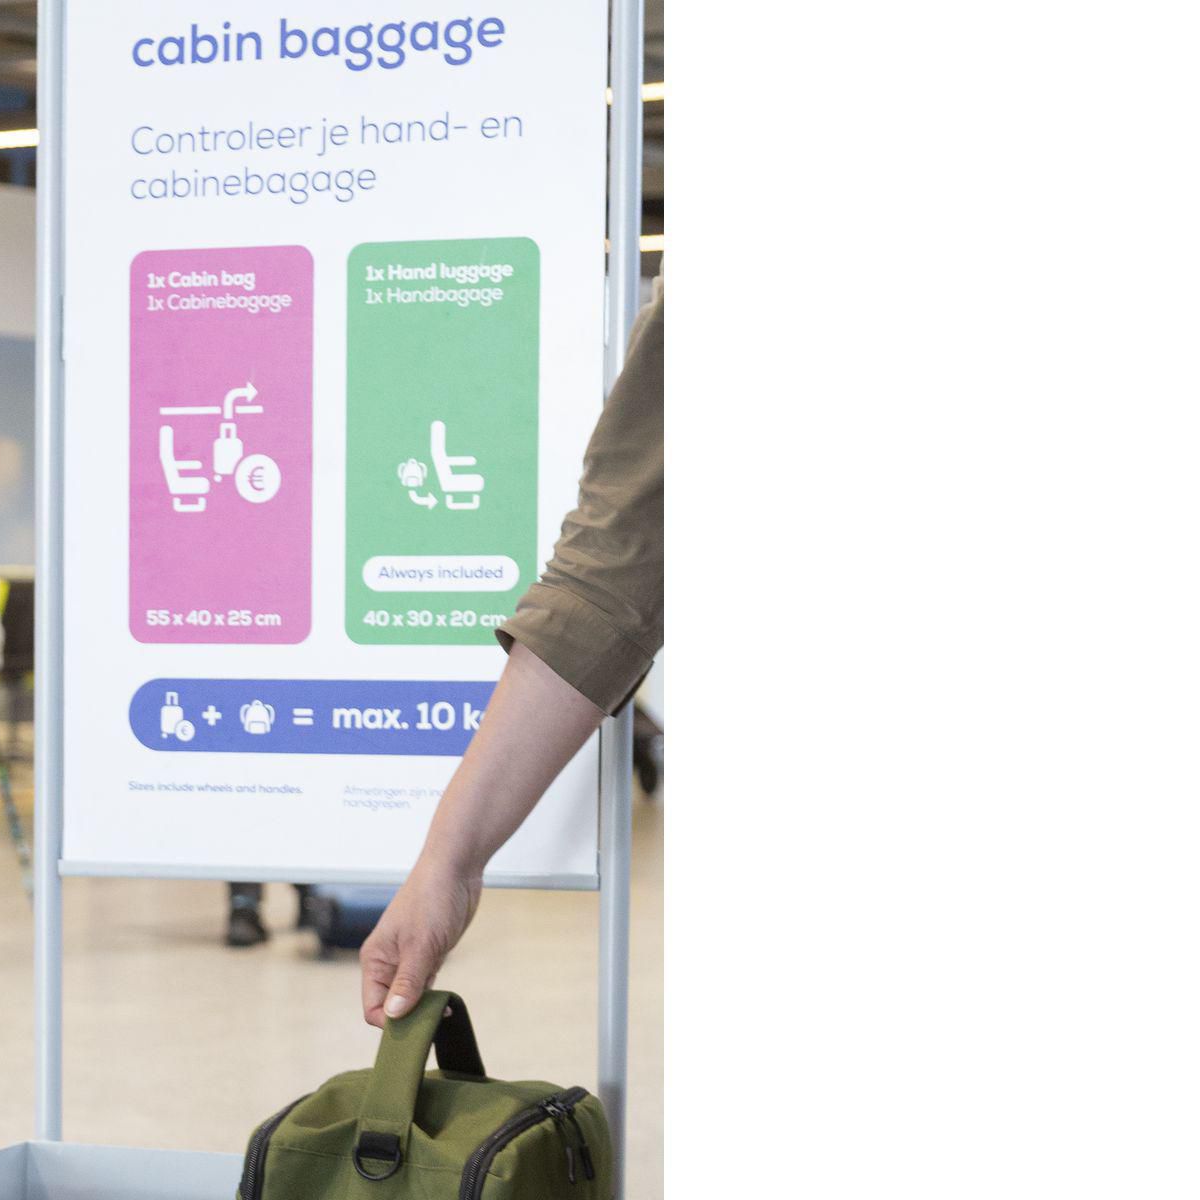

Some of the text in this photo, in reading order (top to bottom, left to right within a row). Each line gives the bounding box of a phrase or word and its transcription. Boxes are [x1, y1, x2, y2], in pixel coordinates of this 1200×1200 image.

[132, 15, 507, 72] cabin baggage
[130, 111, 524, 156] Controleer je hand- en
[130, 166, 377, 204] cabinebagage
[147, 271, 256, 290] 1x Cabin bag
[366, 262, 514, 283] 1x Hand luggage
[147, 293, 292, 313] 1x Cabinebagage
[366, 287, 504, 307] 1x Handbagage
[378, 565, 504, 582] Always included
[146, 610, 282, 626] 55 x 40 x 25 cm
[363, 610, 390, 627] 40
[393, 613, 404, 627] x
[407, 610, 433, 627] 30
[436, 613, 447, 627] x
[450, 610, 477, 627] 20
[332, 706, 409, 730] max.
[416, 701, 456, 730] 10
[463, 702, 487, 731] k
[129, 781, 303, 794] Sizes include wheels and handles.
